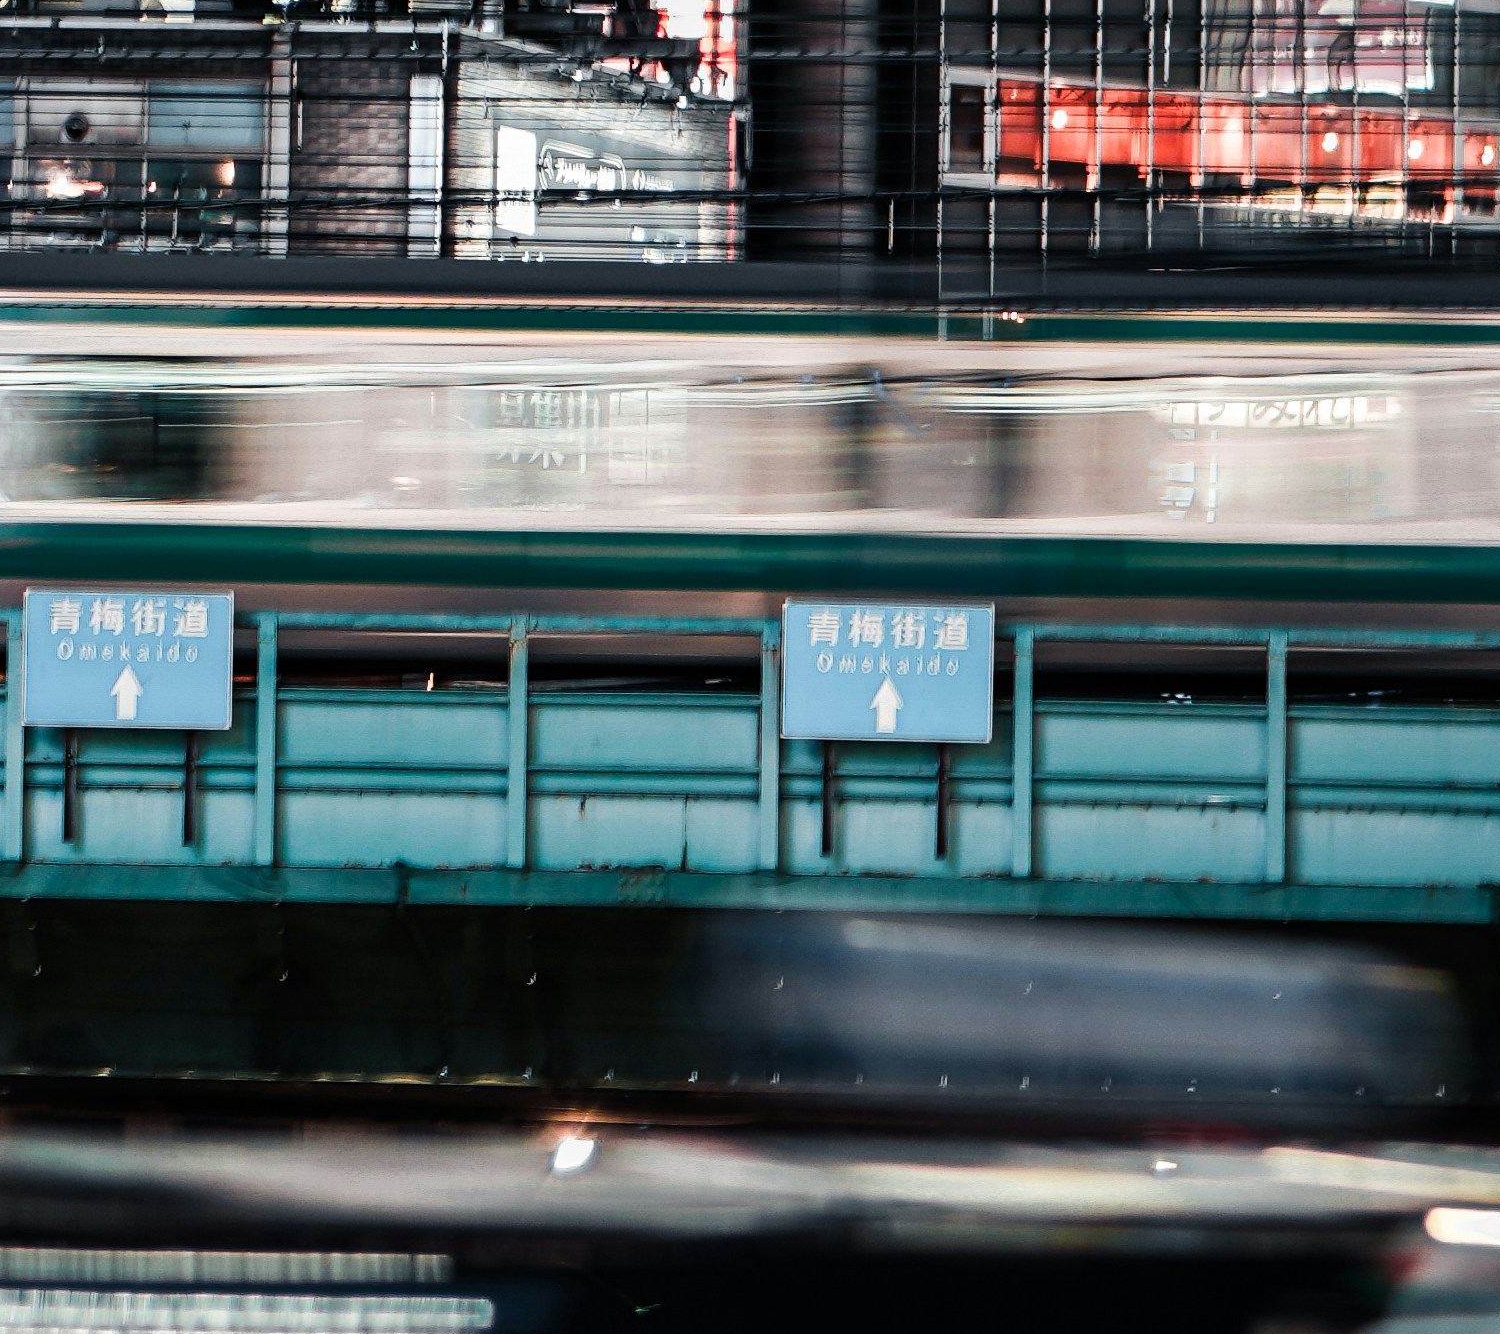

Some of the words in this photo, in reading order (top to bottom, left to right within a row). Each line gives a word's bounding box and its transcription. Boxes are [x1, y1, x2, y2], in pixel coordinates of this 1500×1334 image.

[49, 597, 210, 638] 青梅街道
[806, 608, 970, 651] 青梅街道
